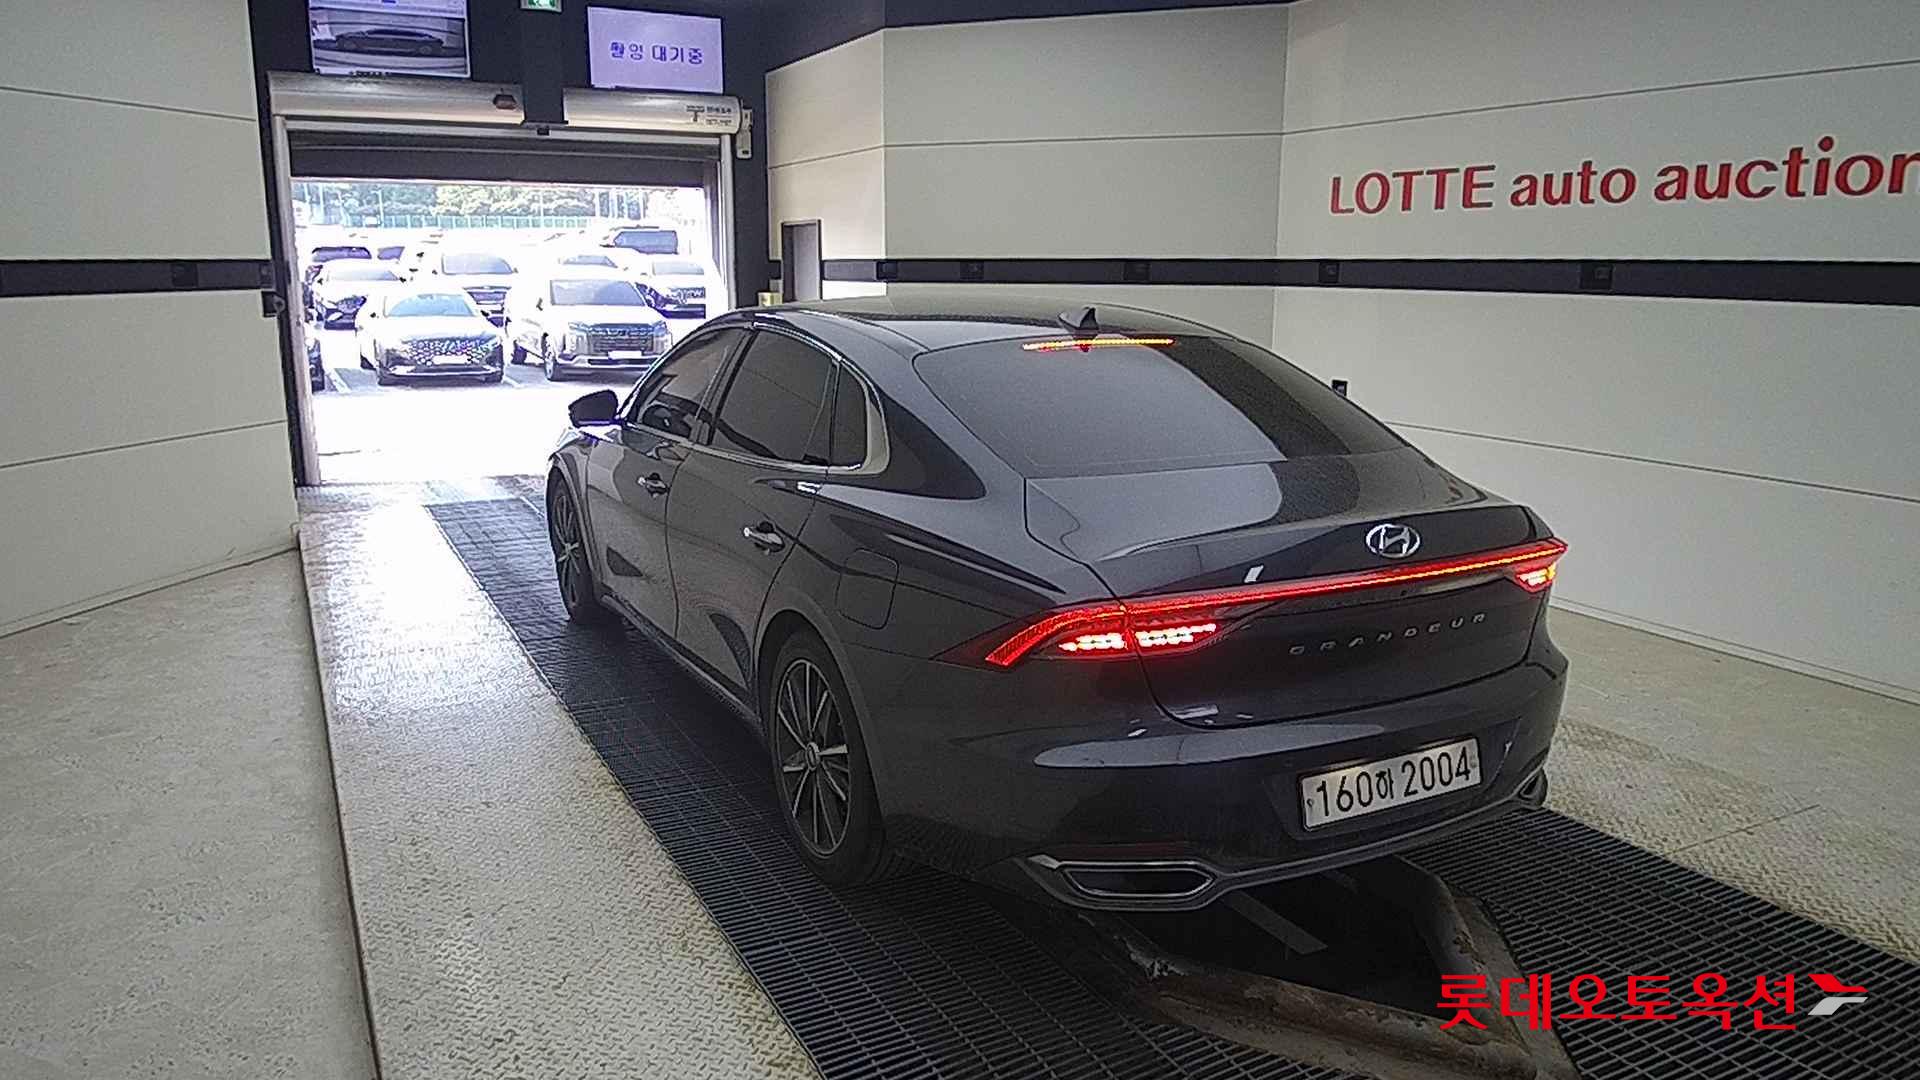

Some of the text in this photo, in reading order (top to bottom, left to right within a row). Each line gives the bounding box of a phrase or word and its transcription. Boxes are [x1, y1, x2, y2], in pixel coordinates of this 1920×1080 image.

[651, 44, 703, 65] 대기중
[1330, 164, 1496, 215] LOTTE
[1510, 160, 1637, 206] auto
[1289, 612, 1486, 655] GRANDEUR
[1316, 746, 1471, 817] 160하 2004
